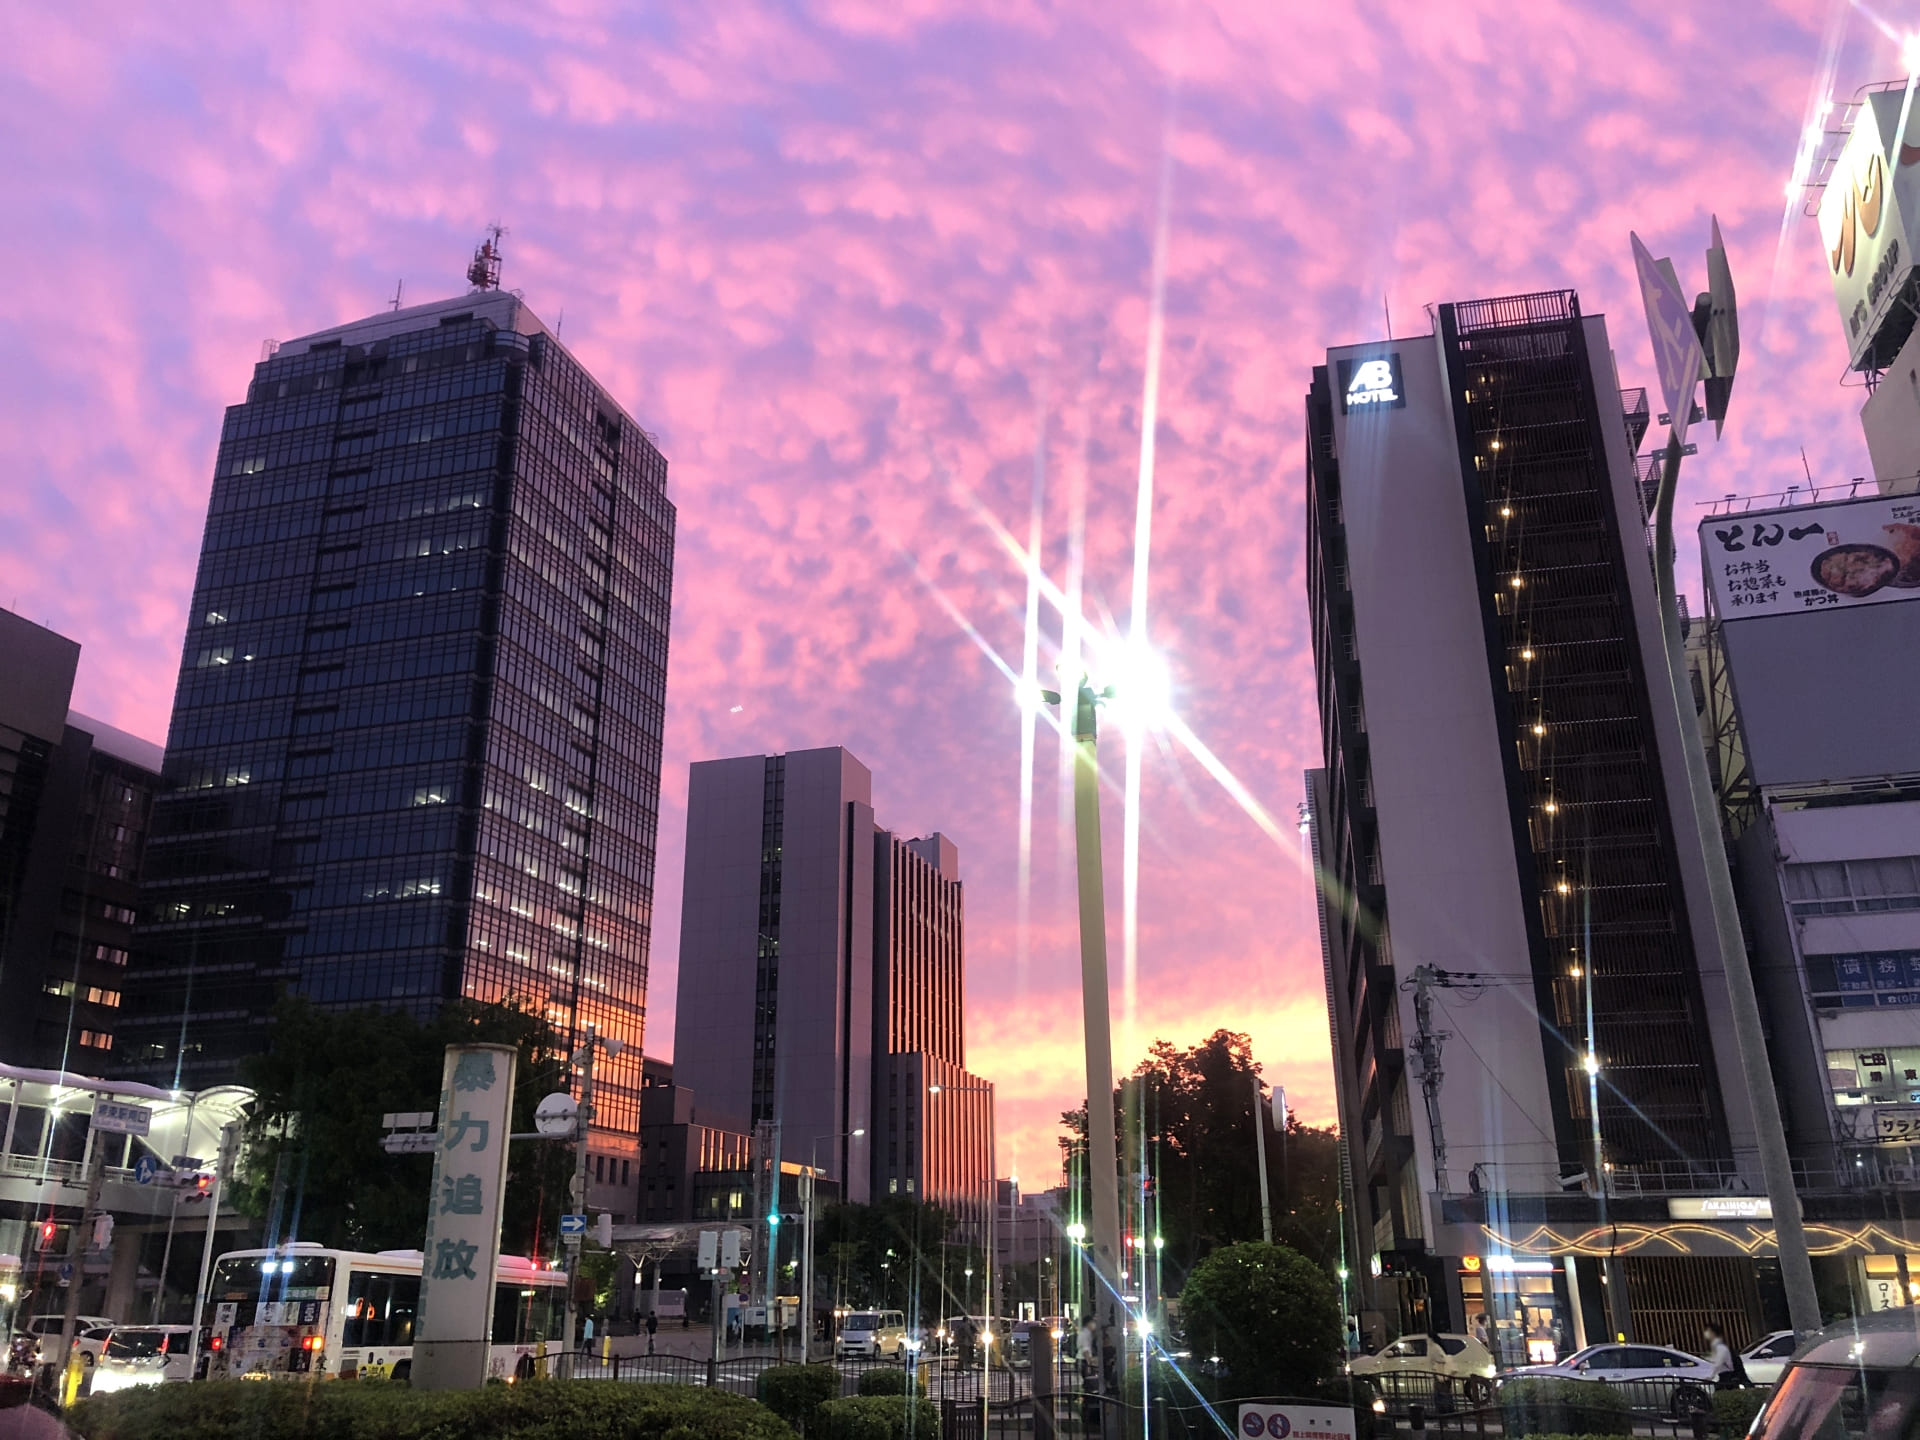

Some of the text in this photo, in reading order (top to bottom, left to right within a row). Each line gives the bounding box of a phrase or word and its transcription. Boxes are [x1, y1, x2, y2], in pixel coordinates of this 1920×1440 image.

[1349, 360, 1393, 392] AB
[1346, 388, 1398, 406] HOTEL
[1724, 559, 1770, 576] お弁当
[1727, 573, 1786, 592] お惣菜も
[1731, 590, 1779, 606] 承ります
[1804, 593, 1839, 606] かつ丼
[1859, 1053, 1886, 1066] 七田
[432, 1051, 497, 1280] 暴力追放
